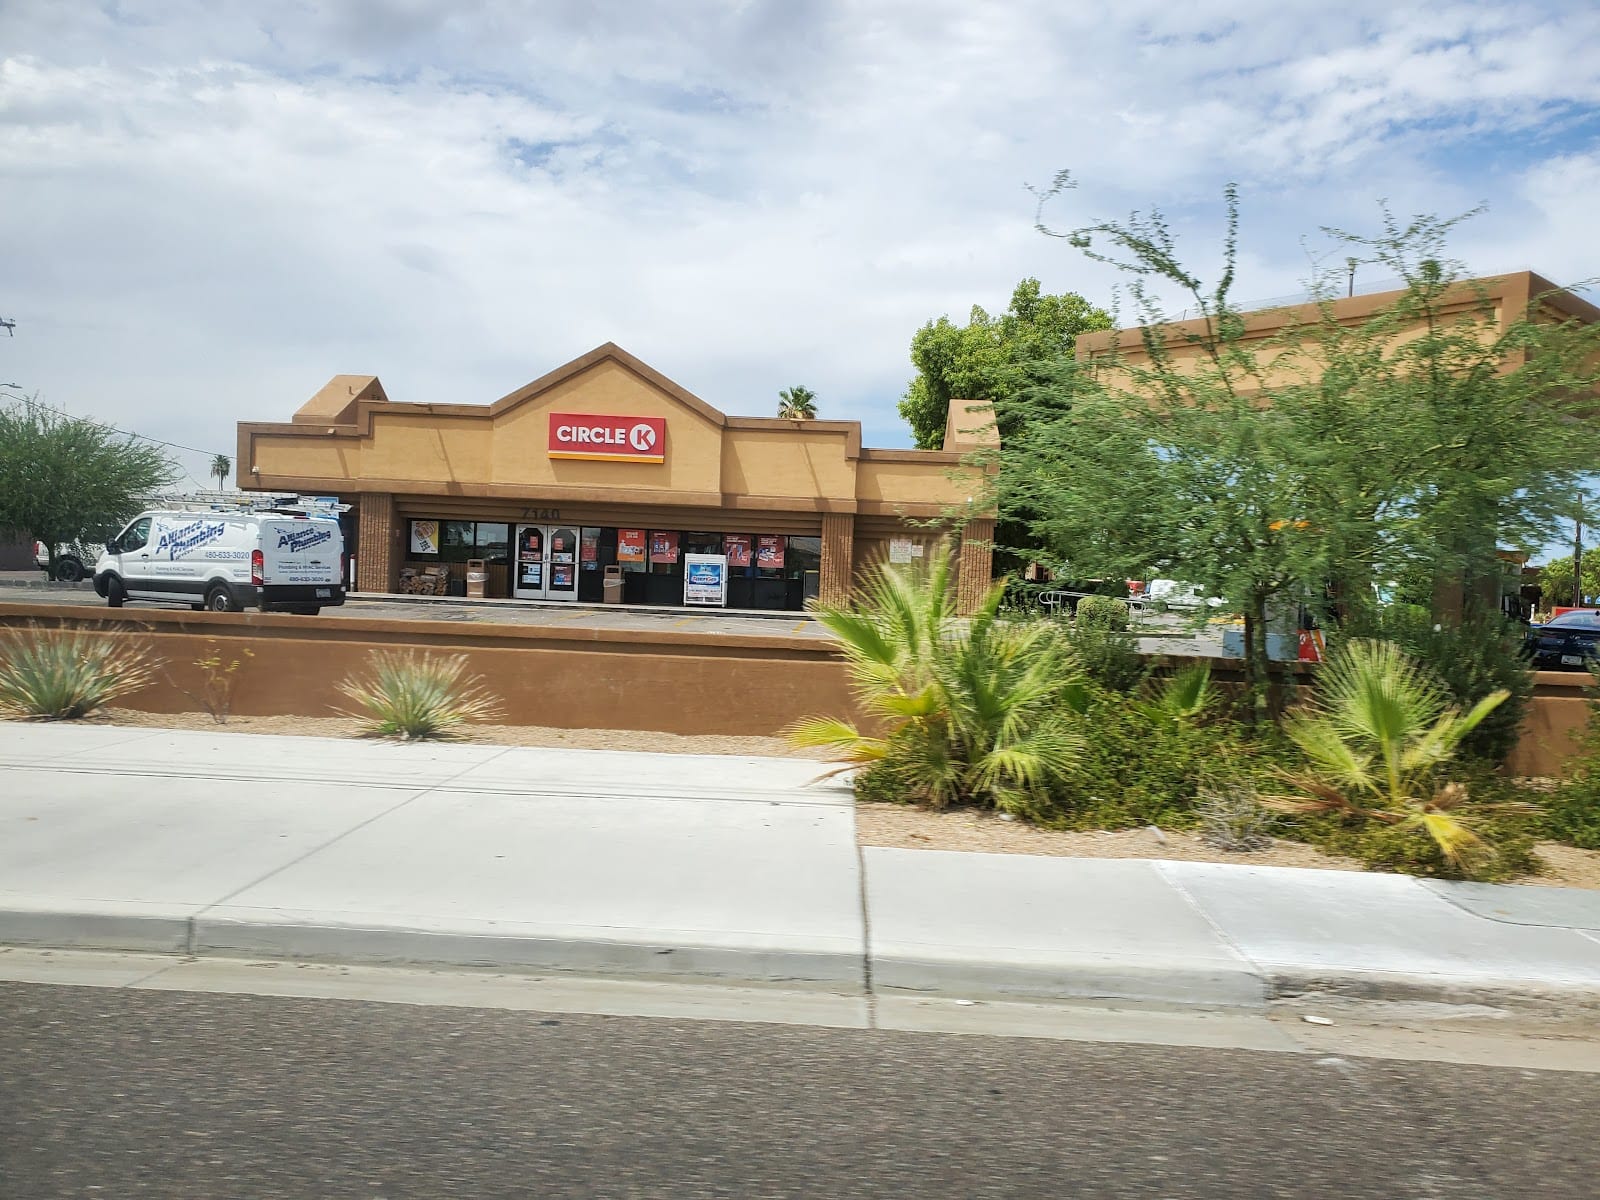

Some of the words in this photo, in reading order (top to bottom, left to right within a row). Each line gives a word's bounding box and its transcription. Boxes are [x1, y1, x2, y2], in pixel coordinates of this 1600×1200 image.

[556, 425, 626, 444] CIRCLE
[631, 425, 656, 450] K
[522, 508, 560, 520] 7140
[156, 520, 203, 555] Alliance
[170, 521, 225, 561] Plumbing
